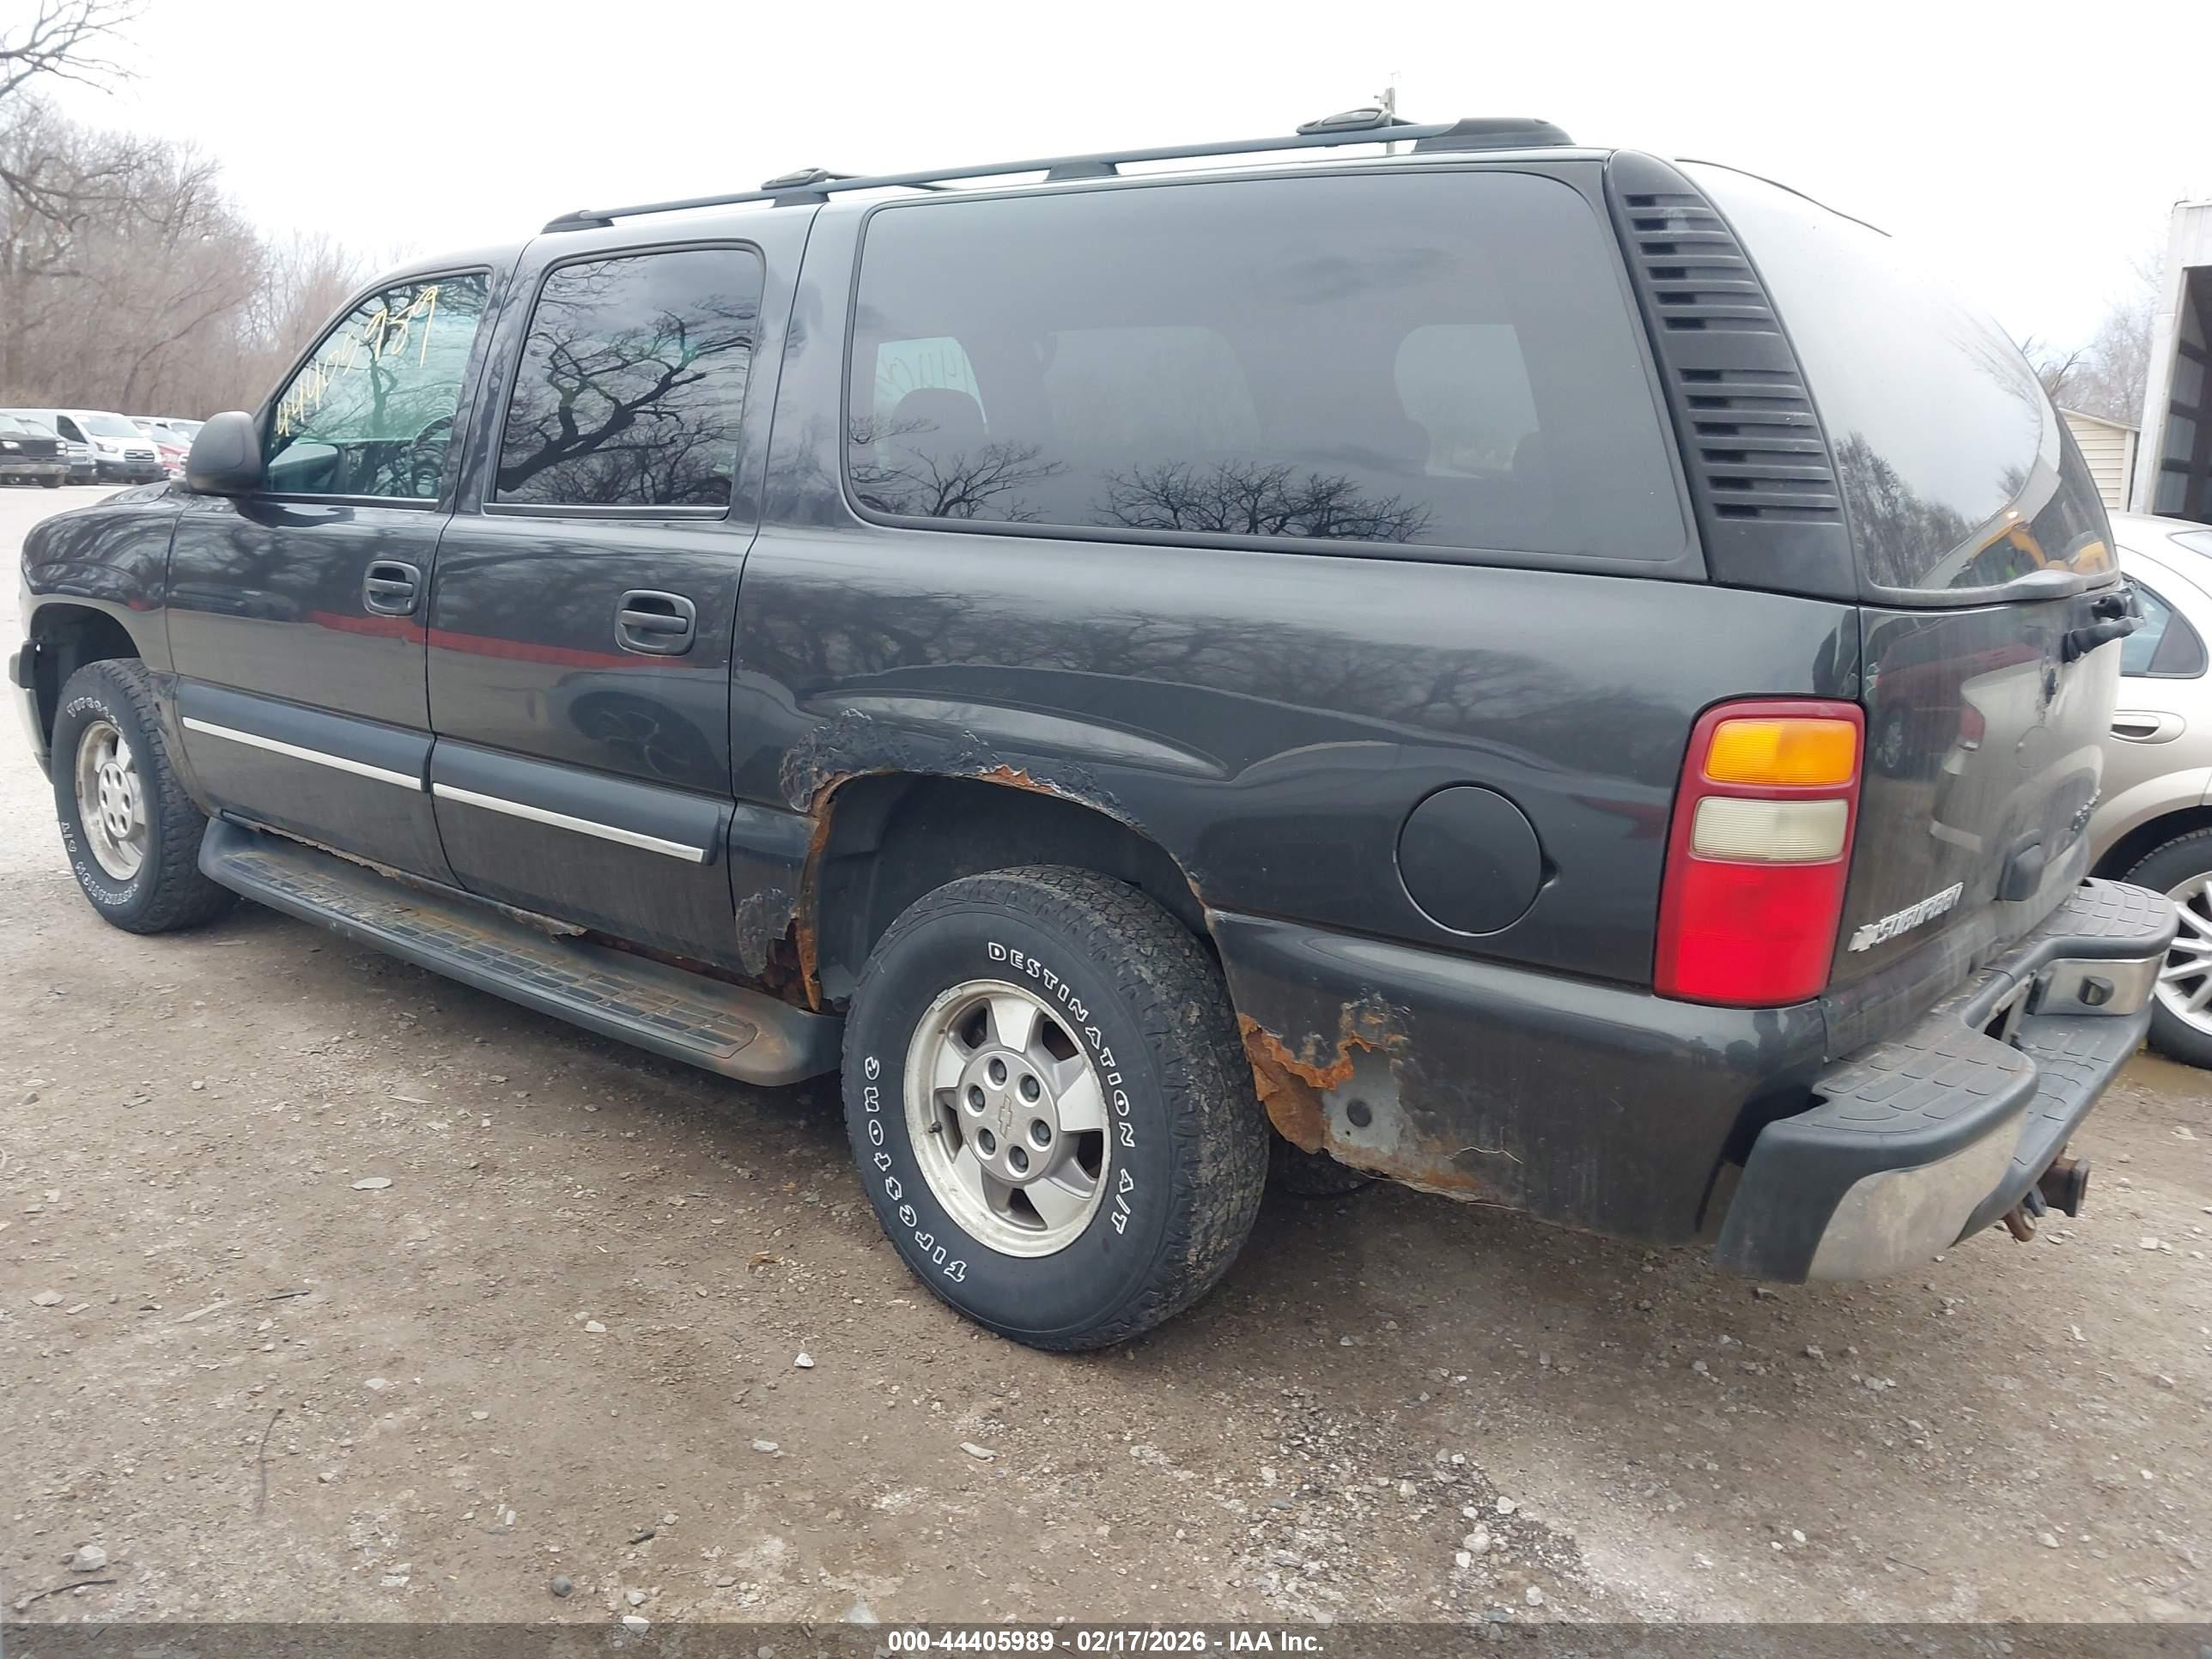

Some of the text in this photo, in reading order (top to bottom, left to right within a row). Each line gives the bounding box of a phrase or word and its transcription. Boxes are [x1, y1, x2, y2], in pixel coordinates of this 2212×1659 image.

[864, 1055, 968, 1283] Firestone
[987, 941, 1136, 1236] DESTINATION A/T
